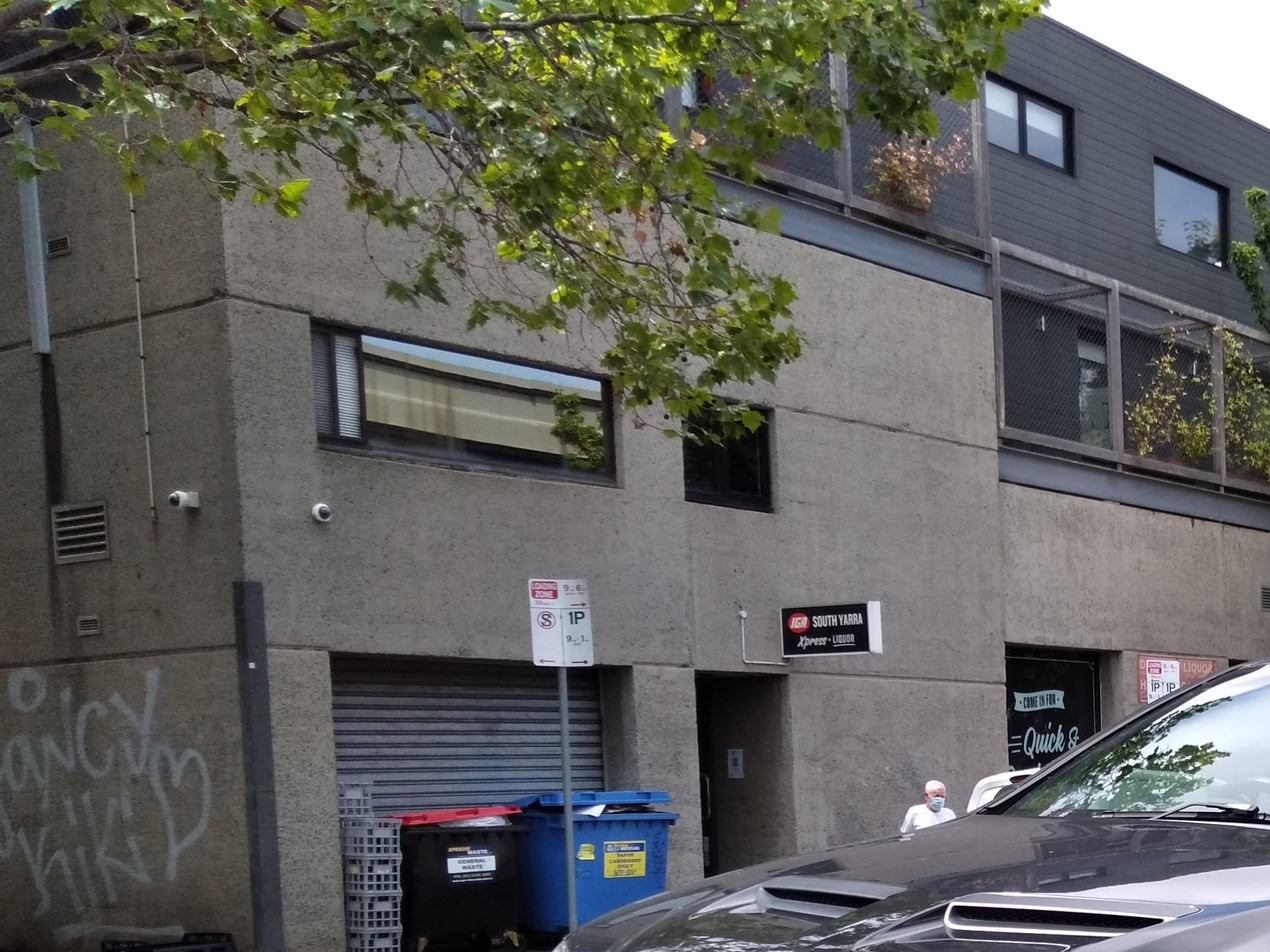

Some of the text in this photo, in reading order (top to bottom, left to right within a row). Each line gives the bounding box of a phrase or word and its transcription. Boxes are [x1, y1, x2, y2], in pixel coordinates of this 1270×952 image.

[532, 582, 557, 590] LOADING
[568, 611, 585, 625] 1P
[790, 613, 863, 629] IGA SOUTH YARRA
[797, 634, 855, 650] Xpress LIQUOR
[1183, 662, 1213, 674] LIQUOR
[1151, 682, 1160, 692] 1P
[1166, 682, 1176, 692] 1P
[1023, 693, 1056, 709] COME IN FOR
[1024, 722, 1066, 760] Quick
